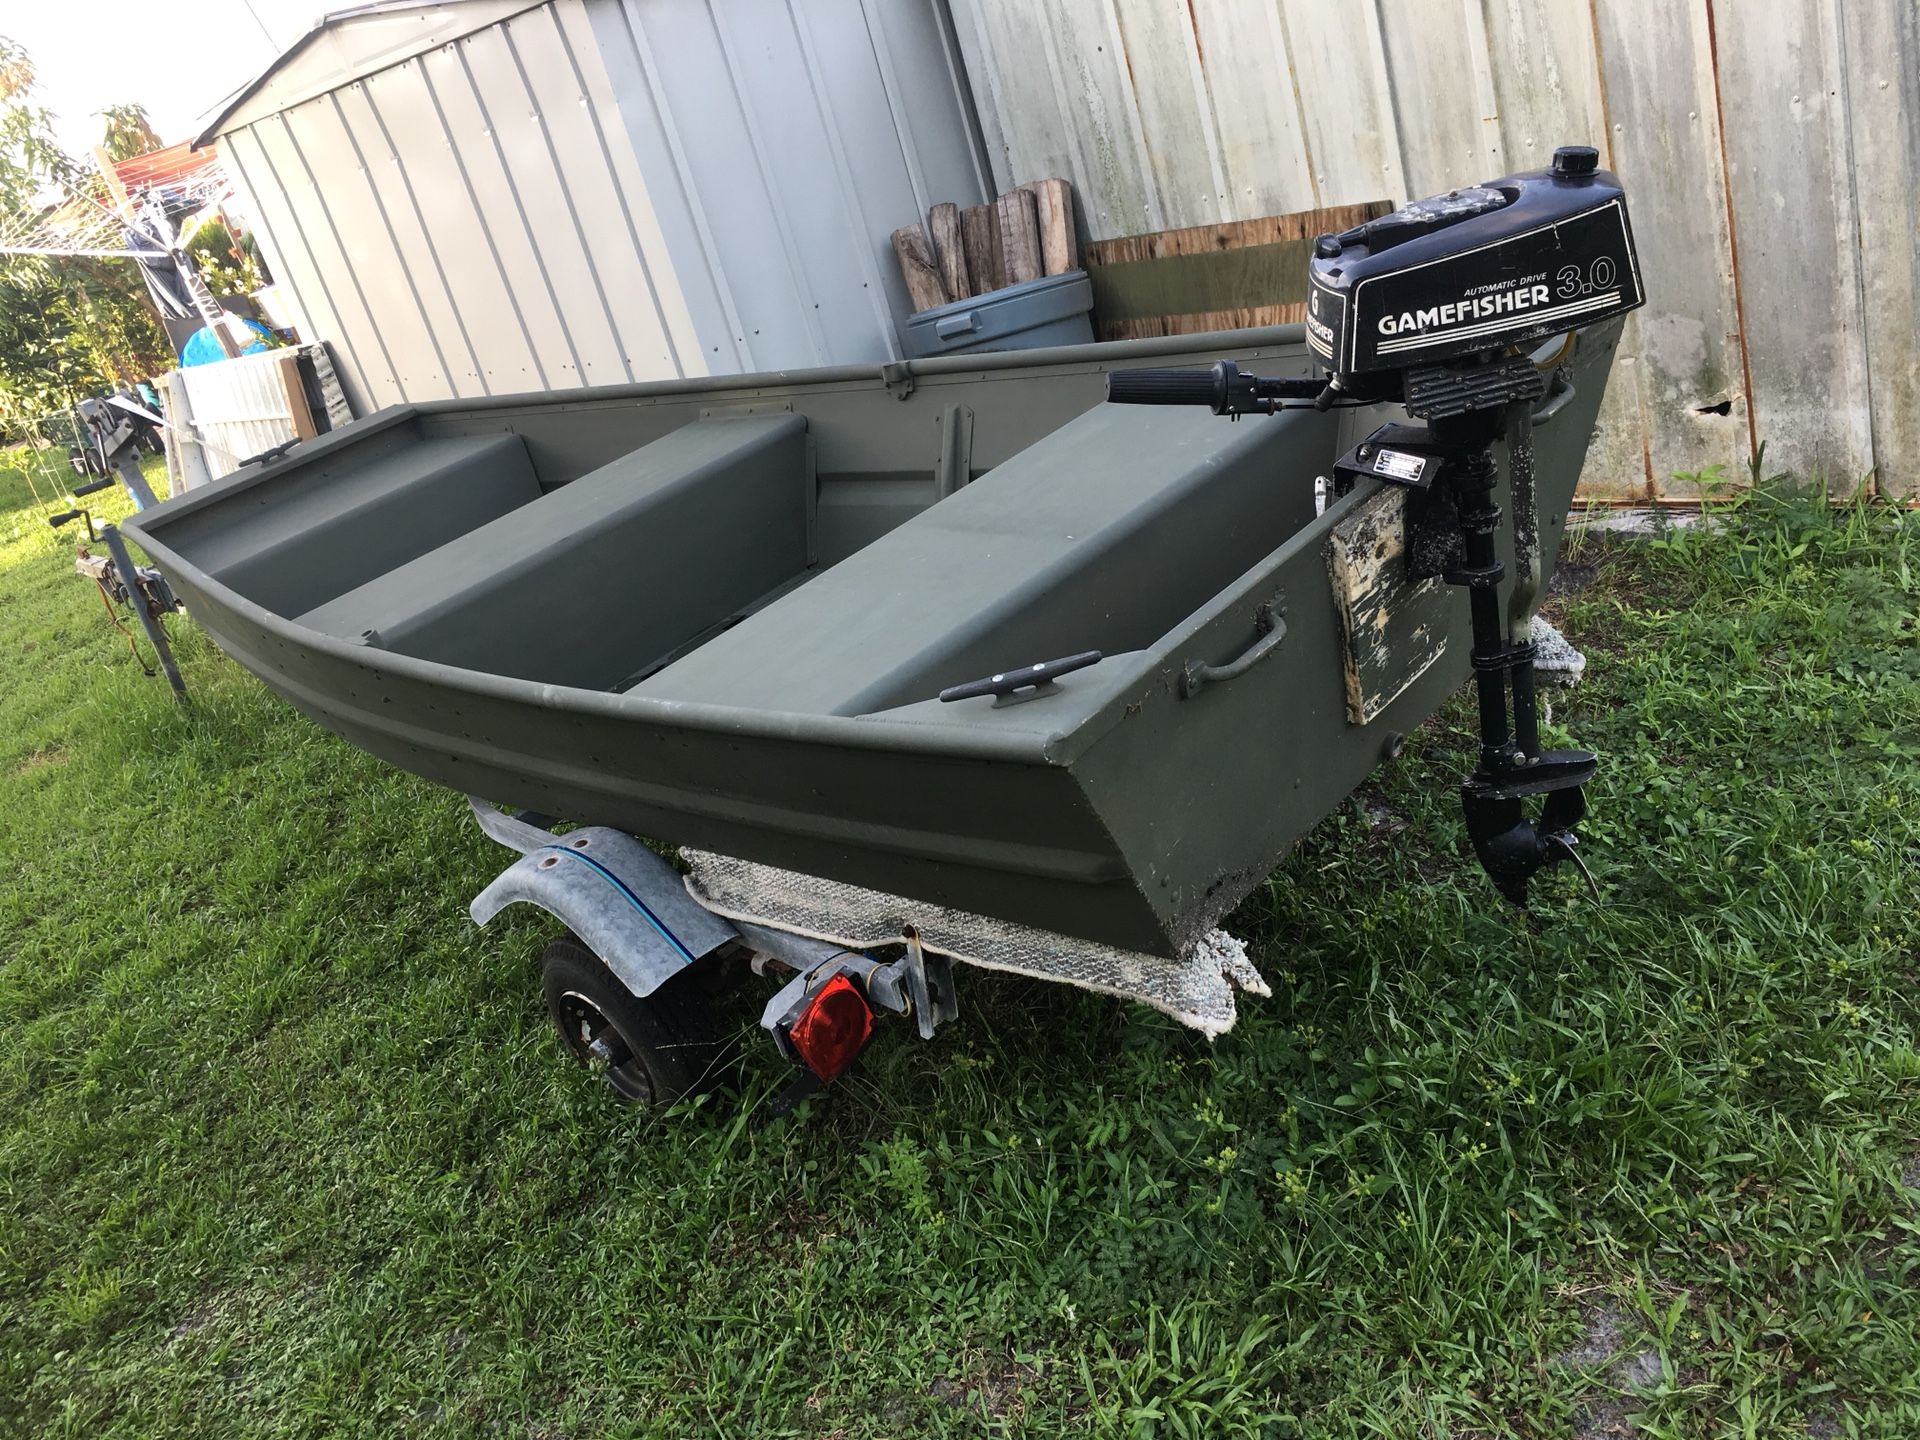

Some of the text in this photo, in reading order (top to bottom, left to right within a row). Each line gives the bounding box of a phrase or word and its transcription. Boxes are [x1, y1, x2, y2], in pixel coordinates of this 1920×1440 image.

[1464, 272, 1548, 297] AUTOMATIC DRIVE
[1556, 255, 1616, 299] 3.0
[1312, 289, 1319, 316] G
[1377, 285, 1550, 335] GAMEFISHER
